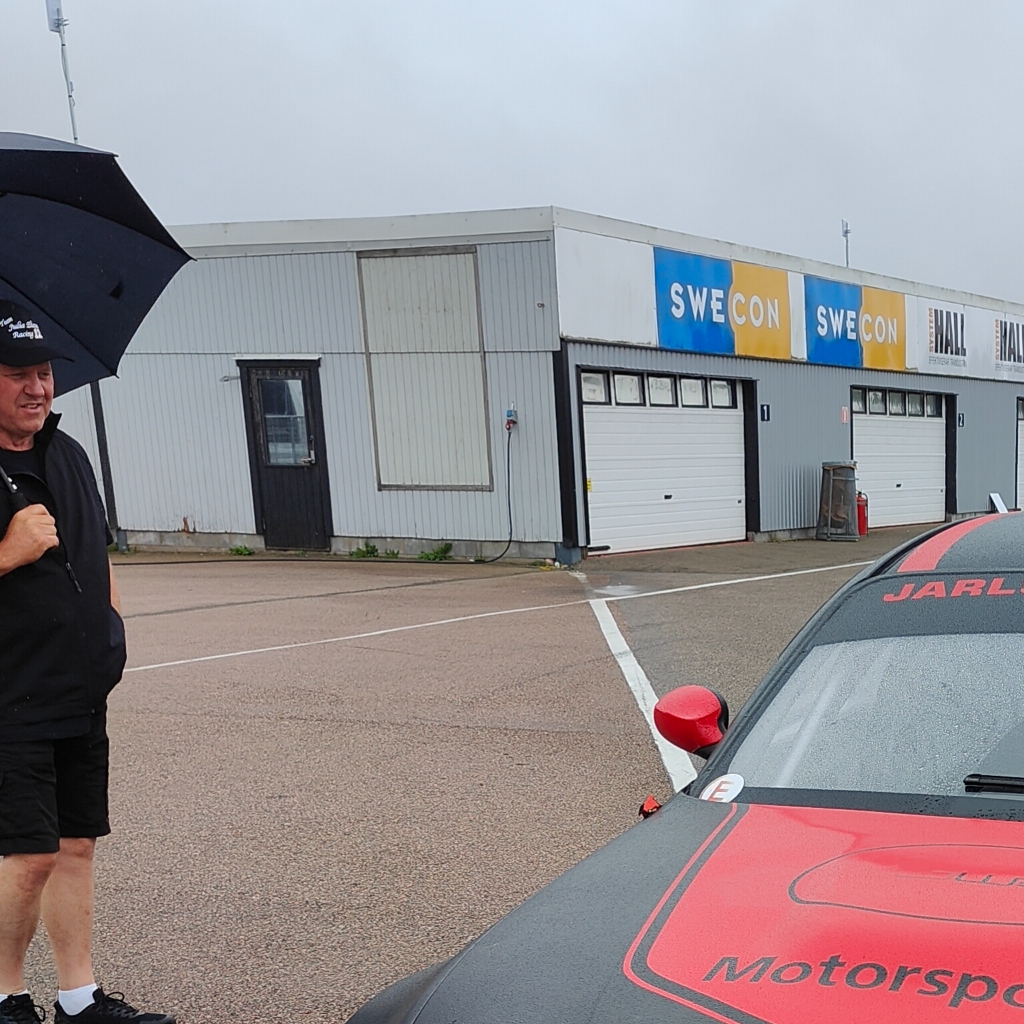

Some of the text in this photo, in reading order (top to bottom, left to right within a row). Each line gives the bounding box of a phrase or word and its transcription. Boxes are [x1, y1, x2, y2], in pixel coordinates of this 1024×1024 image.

[670, 282, 780, 330] SWECON
[816, 304, 898, 345] SWECON
[934, 308, 966, 357] HALL
[708, 780, 736, 803] E
